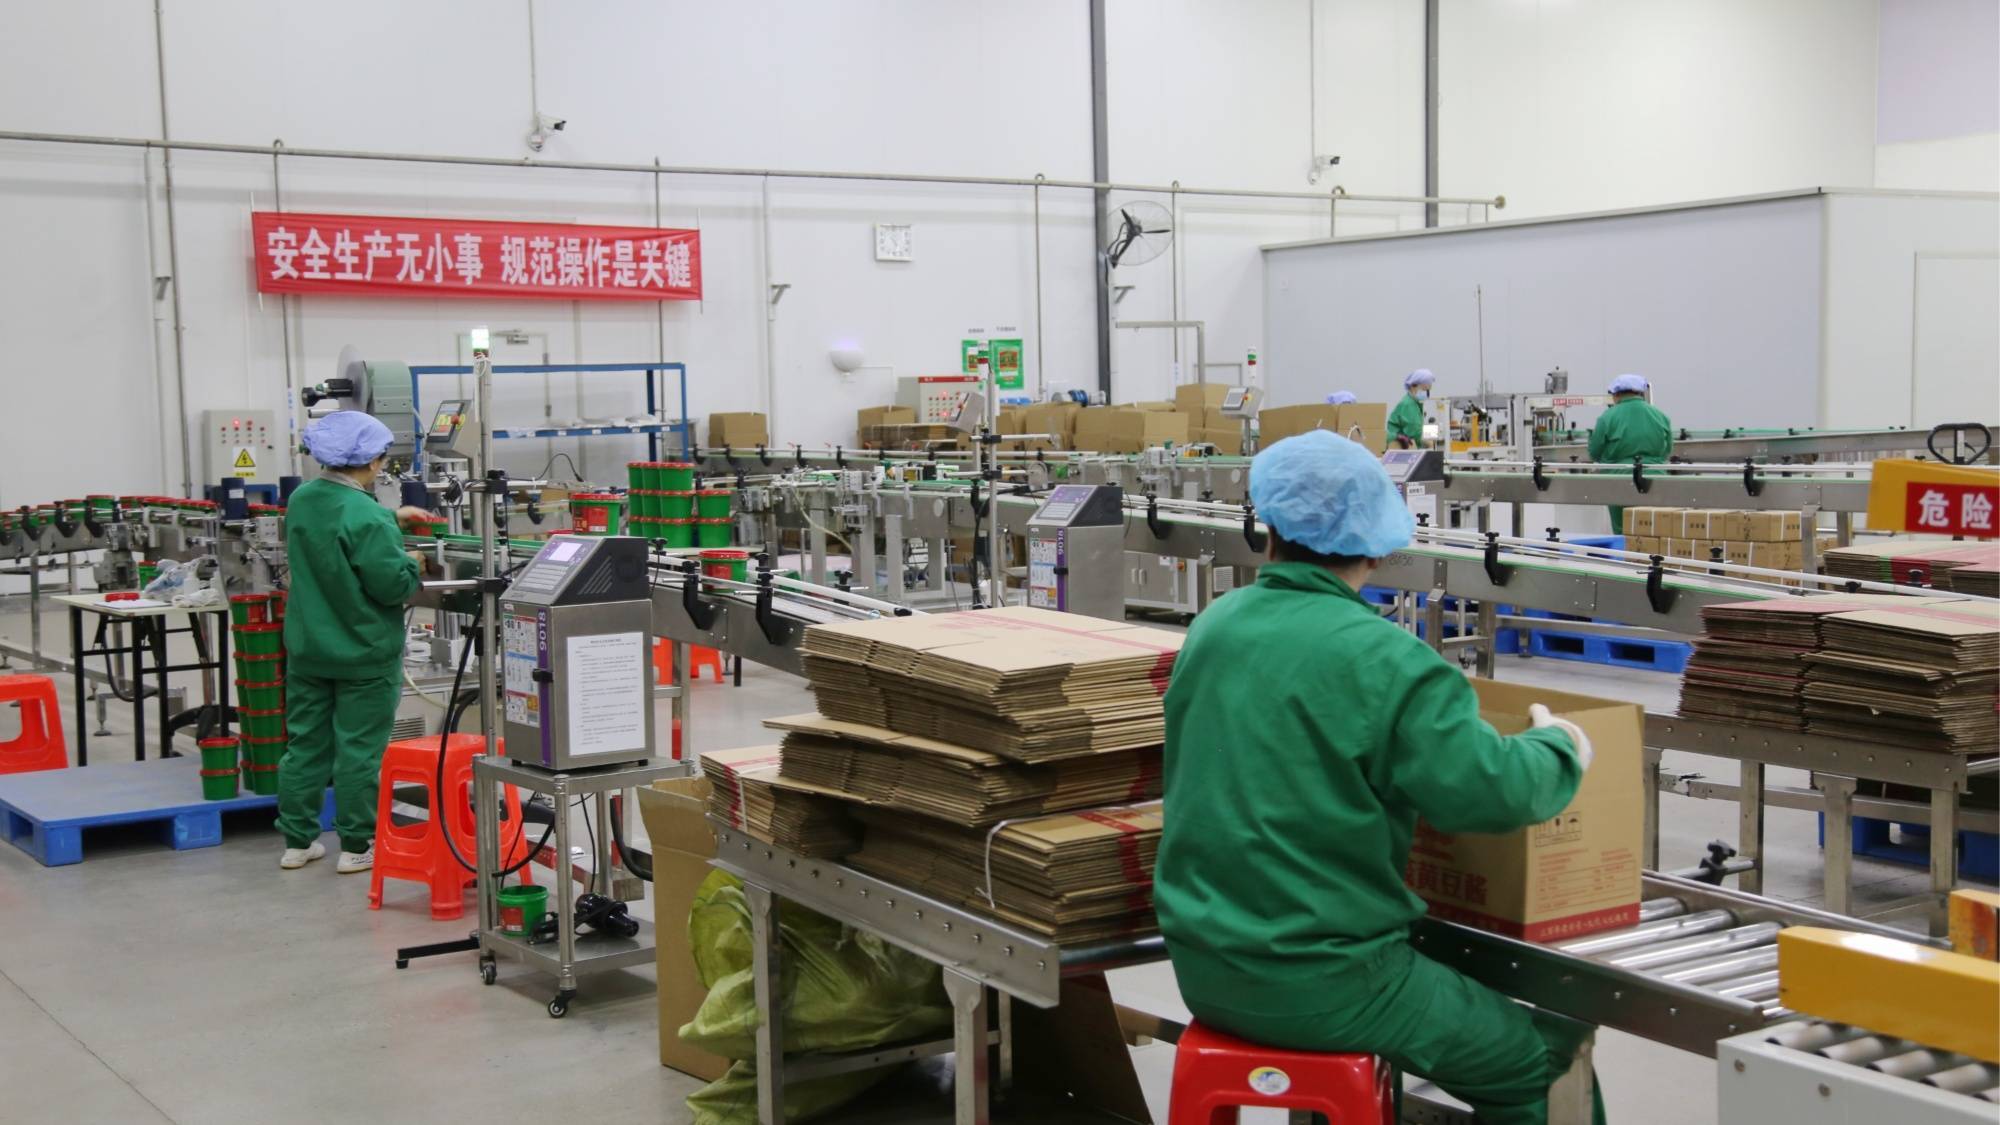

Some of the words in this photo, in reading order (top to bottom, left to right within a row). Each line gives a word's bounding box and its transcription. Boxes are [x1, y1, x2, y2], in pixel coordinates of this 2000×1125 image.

[267, 226, 484, 285] 安全生产无小事
[500, 234, 692, 289] 规范操作是关键
[1918, 489, 1993, 529] 危险
[539, 611, 547, 651] 9018
